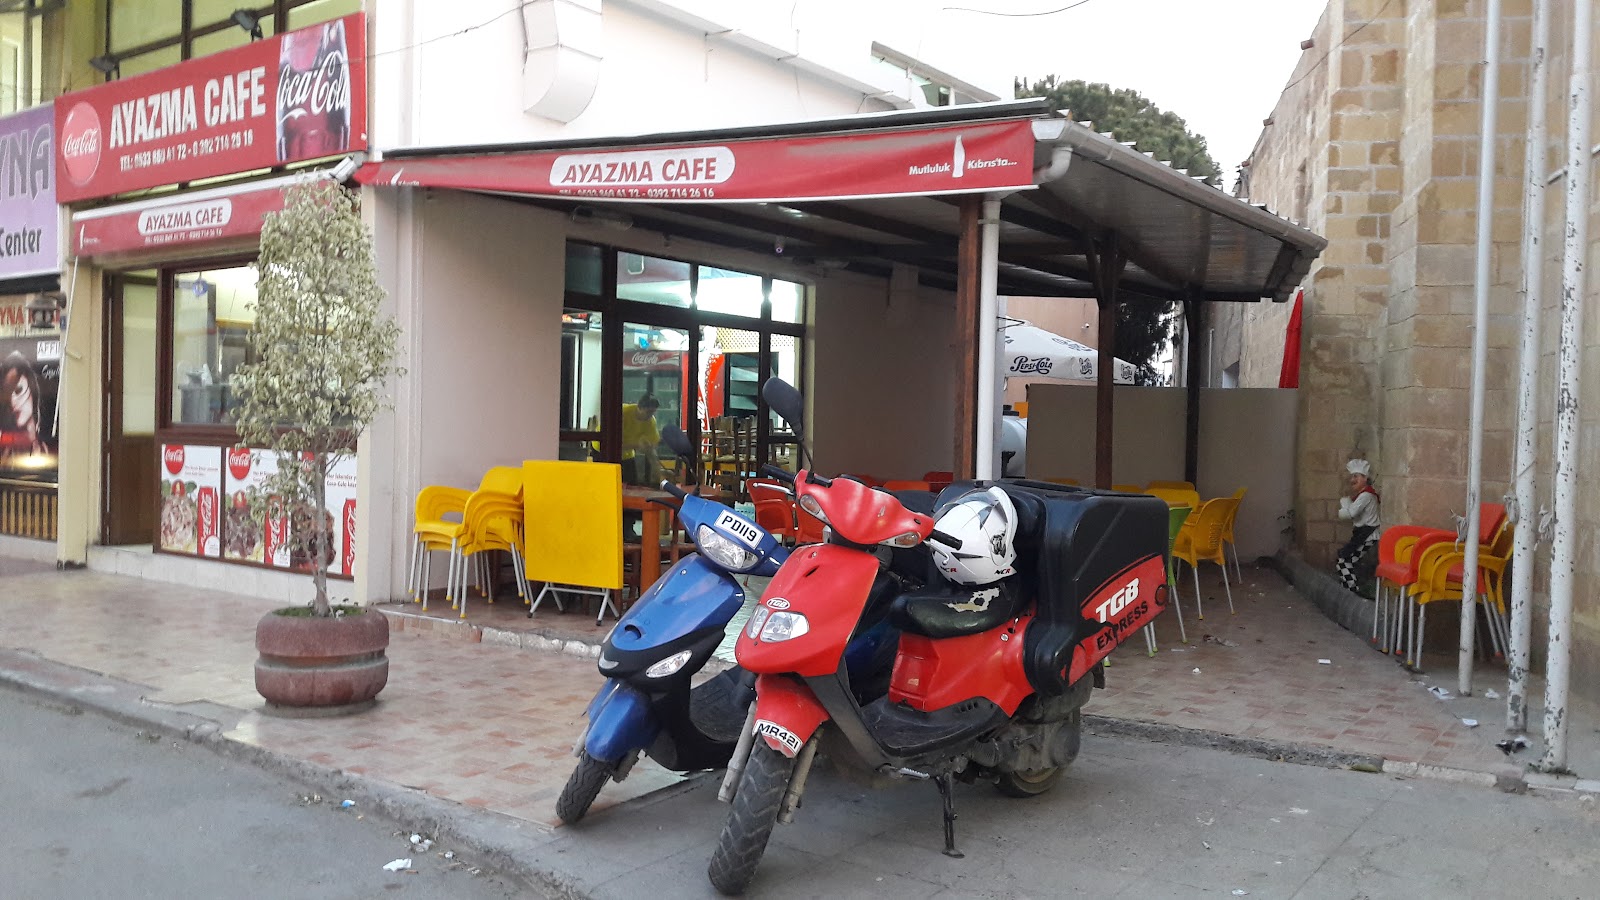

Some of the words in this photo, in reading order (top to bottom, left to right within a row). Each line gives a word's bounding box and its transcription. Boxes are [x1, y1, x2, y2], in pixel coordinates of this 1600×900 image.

[110, 85, 197, 150] AYAZMA
[204, 66, 266, 127] CAFE
[177, 144, 187, 160] 72
[561, 161, 653, 183] AYAZMA
[662, 157, 717, 182] CAFE
[909, 162, 951, 176] Mutluluk
[628, 188, 640, 198] 72
[648, 188, 670, 198] 0392
[670, 188, 688, 198] 714
[689, 188, 700, 198] 26
[703, 188, 714, 198] 16
[145, 211, 192, 232] AYAZMA
[196, 206, 223, 226] CAFE
[0, 223, 42, 258] Center
[632, 352, 660, 365] Coca-Cola
[722, 516, 756, 542] PD119
[770, 598, 788, 608] TGB
[1096, 578, 1139, 624] TGB
[1096, 600, 1148, 650] EXPRESS
[759, 723, 798, 749] MR421
